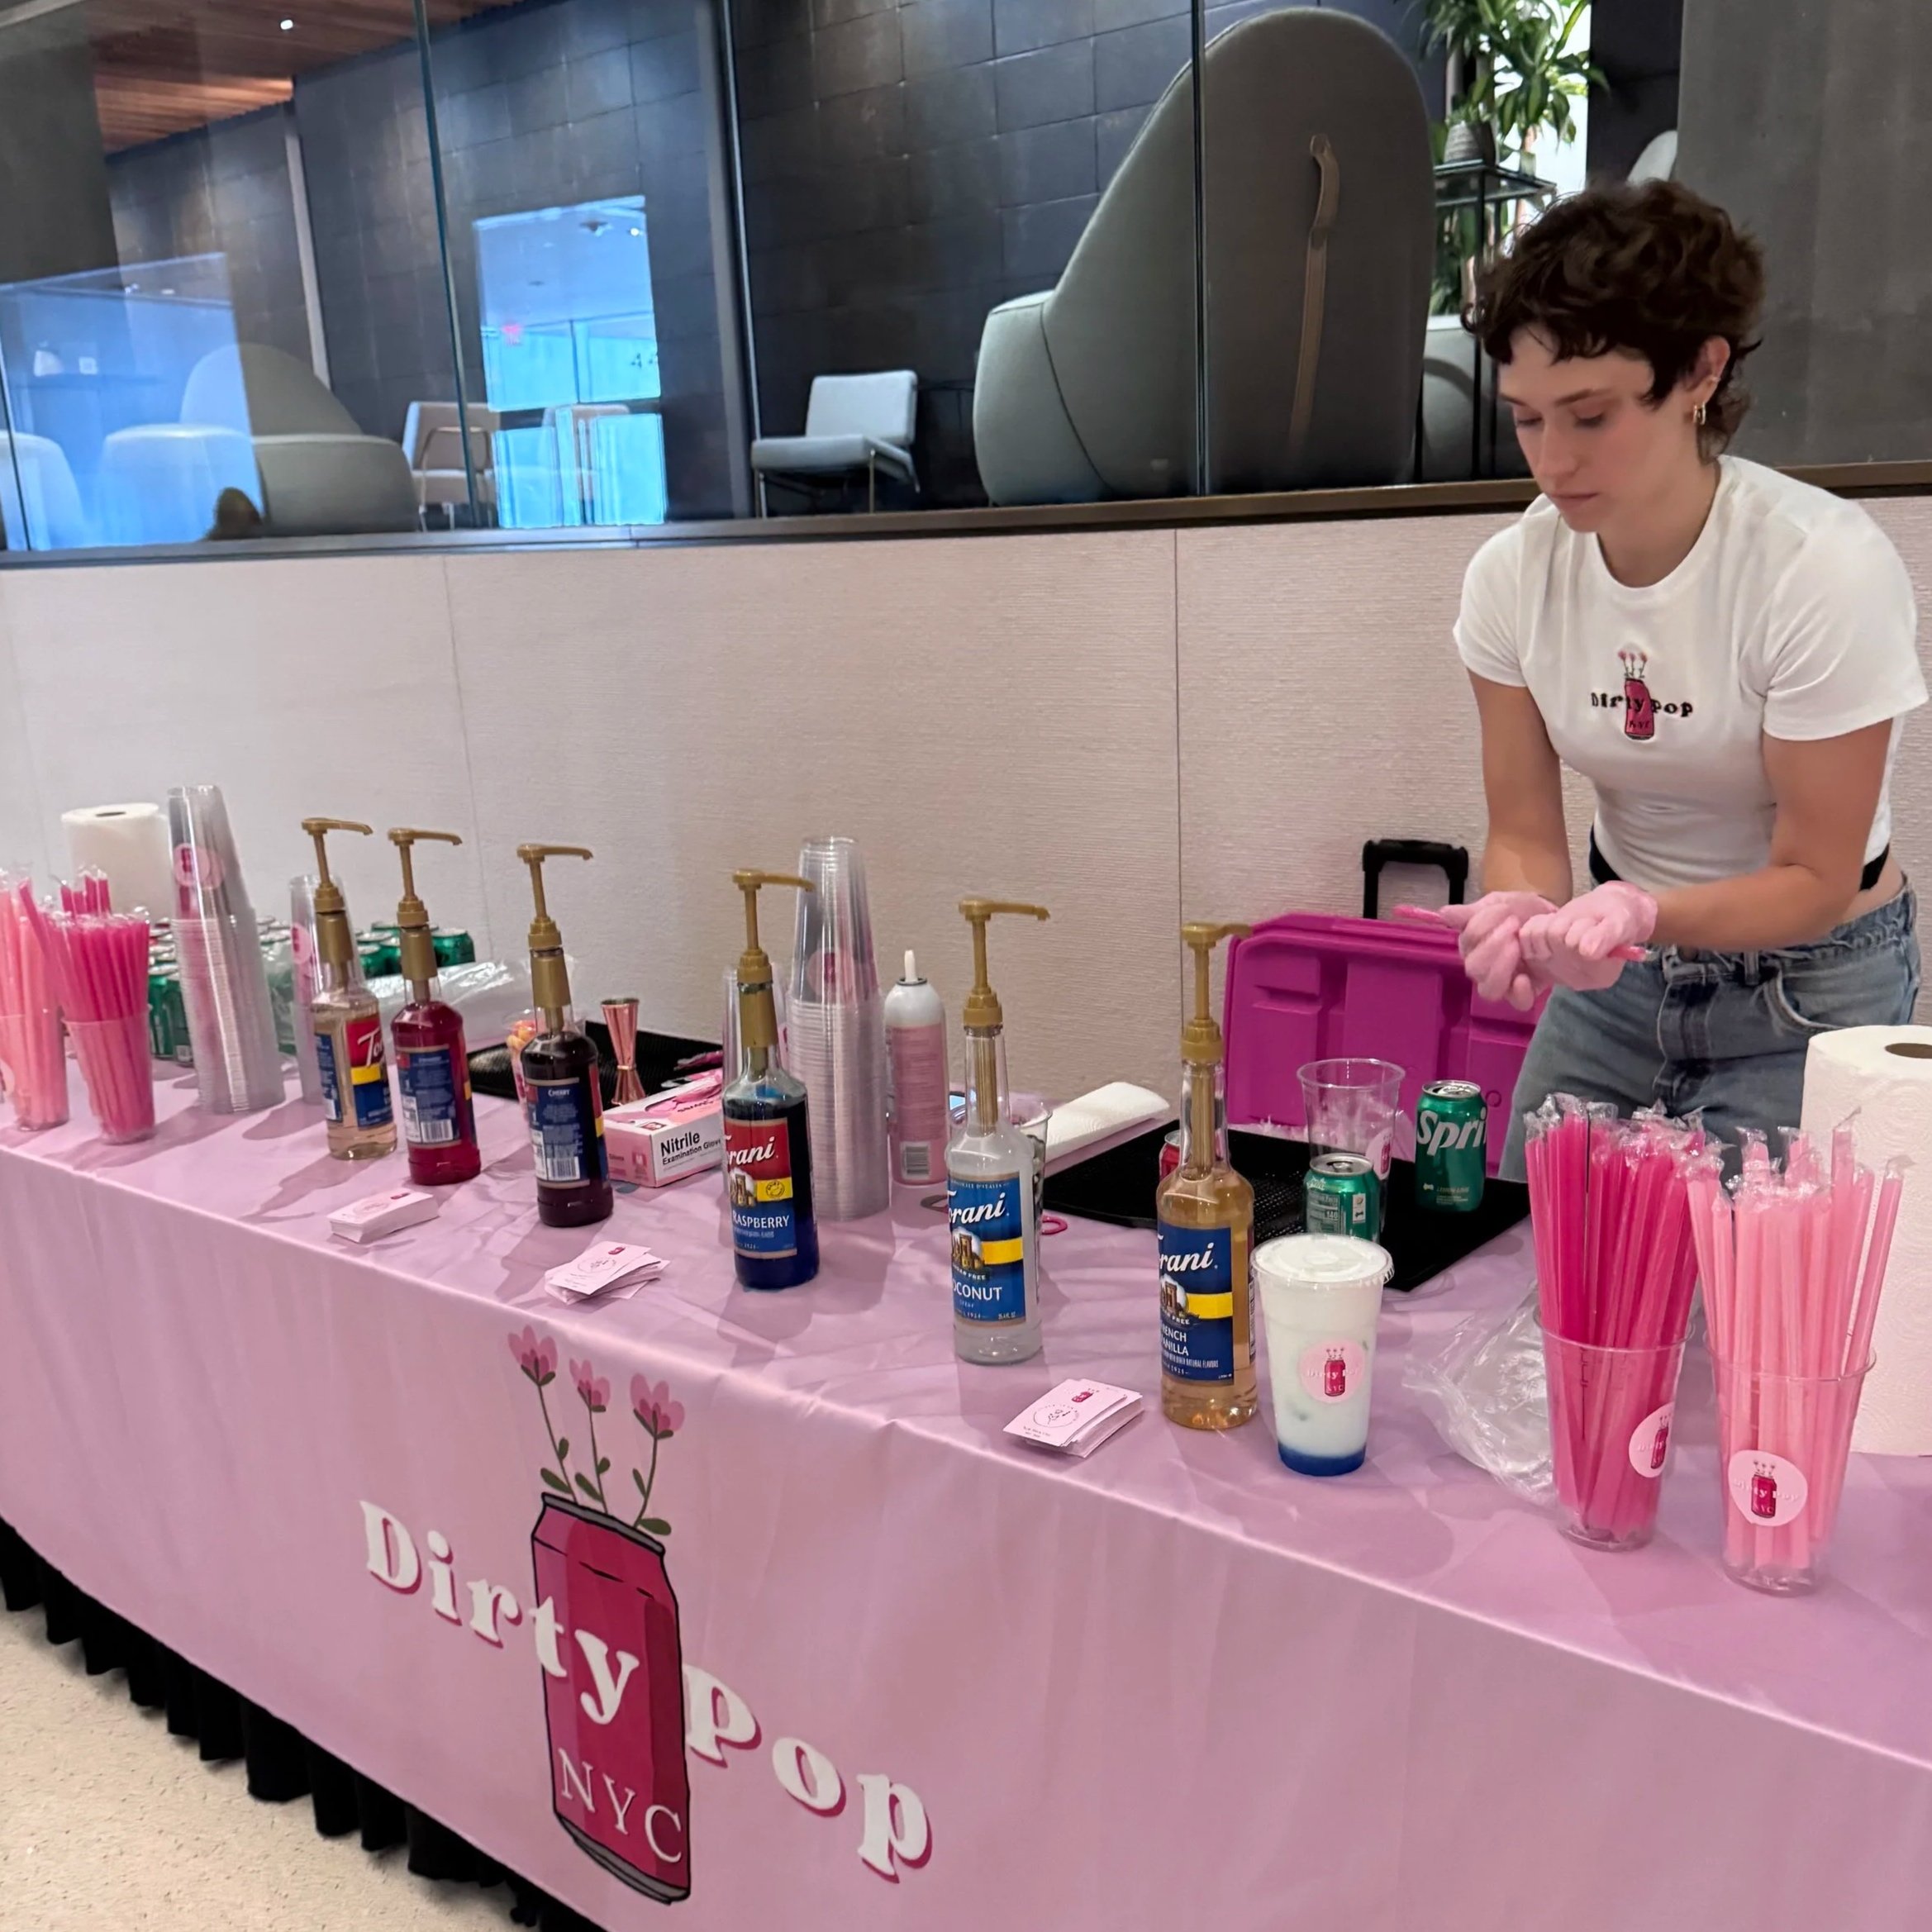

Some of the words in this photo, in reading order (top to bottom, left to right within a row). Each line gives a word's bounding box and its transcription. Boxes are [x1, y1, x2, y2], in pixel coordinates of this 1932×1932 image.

[660, 1131, 701, 1157] Nitrile
[1417, 1106, 1487, 1156] Spri
[662, 1145, 702, 1165] Examination
[732, 1210, 790, 1230] RASPBERRY
[359, 1501, 640, 1725] Dirty
[684, 1663, 932, 1882] Pop
[559, 1748, 683, 1863] NYC
